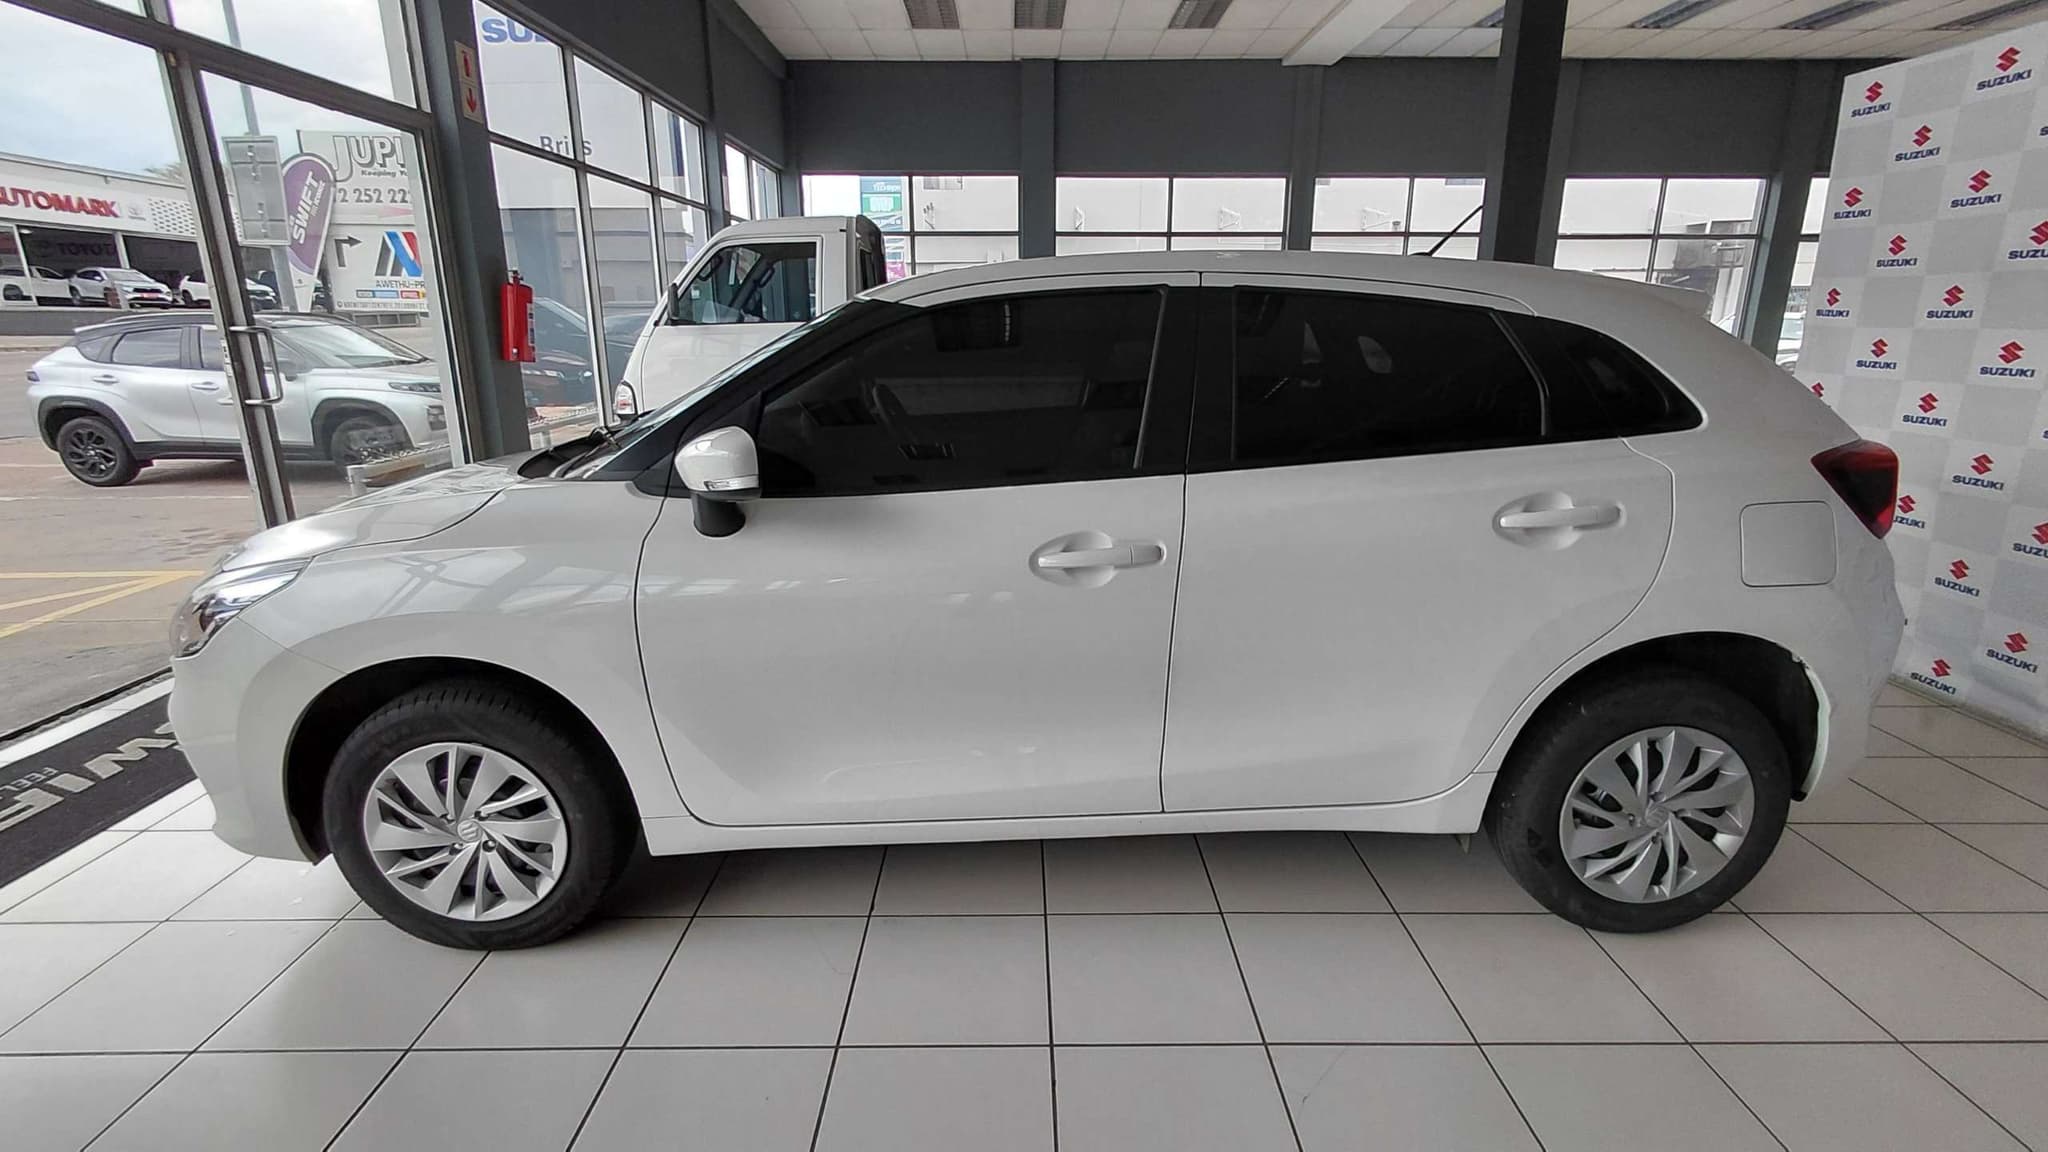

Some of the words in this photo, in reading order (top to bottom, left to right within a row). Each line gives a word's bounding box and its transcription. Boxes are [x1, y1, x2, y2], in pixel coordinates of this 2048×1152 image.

[1977, 69, 2031, 91] SUZUKI
[1851, 102, 1891, 118] SUZUKI
[540, 135, 593, 156] Bris
[1895, 147, 1940, 162] SUZUKI
[353, 187, 384, 204] 252
[1950, 193, 2002, 208] SUZUKI
[292, 171, 319, 244] SWIFT
[1834, 208, 1872, 220] SUZUKI
[1876, 257, 1918, 268] SUZUKI
[1816, 308, 1849, 318] SUZUKI
[1926, 309, 1974, 319] SUZUKI
[1856, 360, 1897, 370] SUZUKI
[1979, 366, 2035, 378] SUZUKI
[1902, 414, 1947, 427] SUZUKI
[1952, 474, 2004, 491] SUZUKI
[1893, 515, 1925, 530] UZUKI
[1933, 576, 1980, 598] SUZUKI
[1986, 648, 2039, 674] SUZUKI
[1910, 671, 1957, 696] SUZUKI
